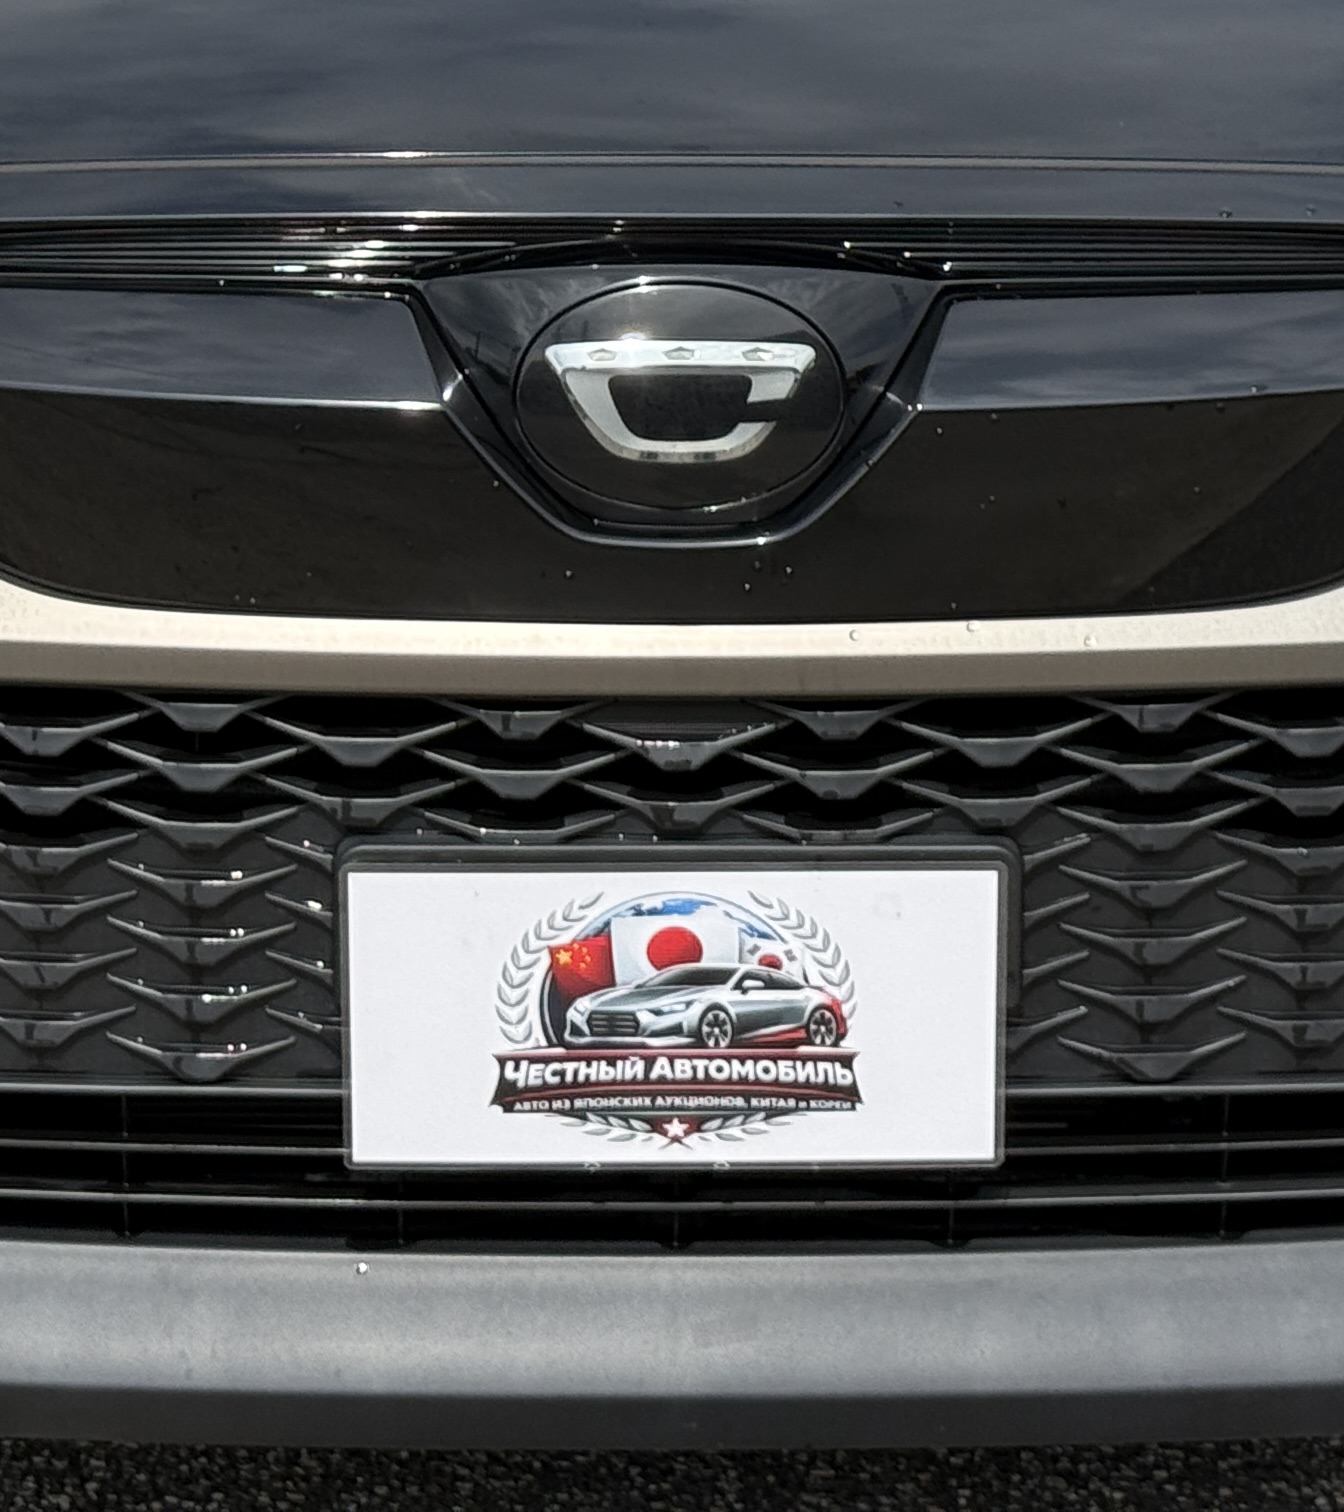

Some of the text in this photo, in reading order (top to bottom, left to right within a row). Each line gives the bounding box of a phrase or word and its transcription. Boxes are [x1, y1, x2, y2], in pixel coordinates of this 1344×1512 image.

[504, 1056, 854, 1089] ЧЕСТНЫЙ АВТОМОБИЛЬ
[513, 1099, 550, 1111] АВТО
